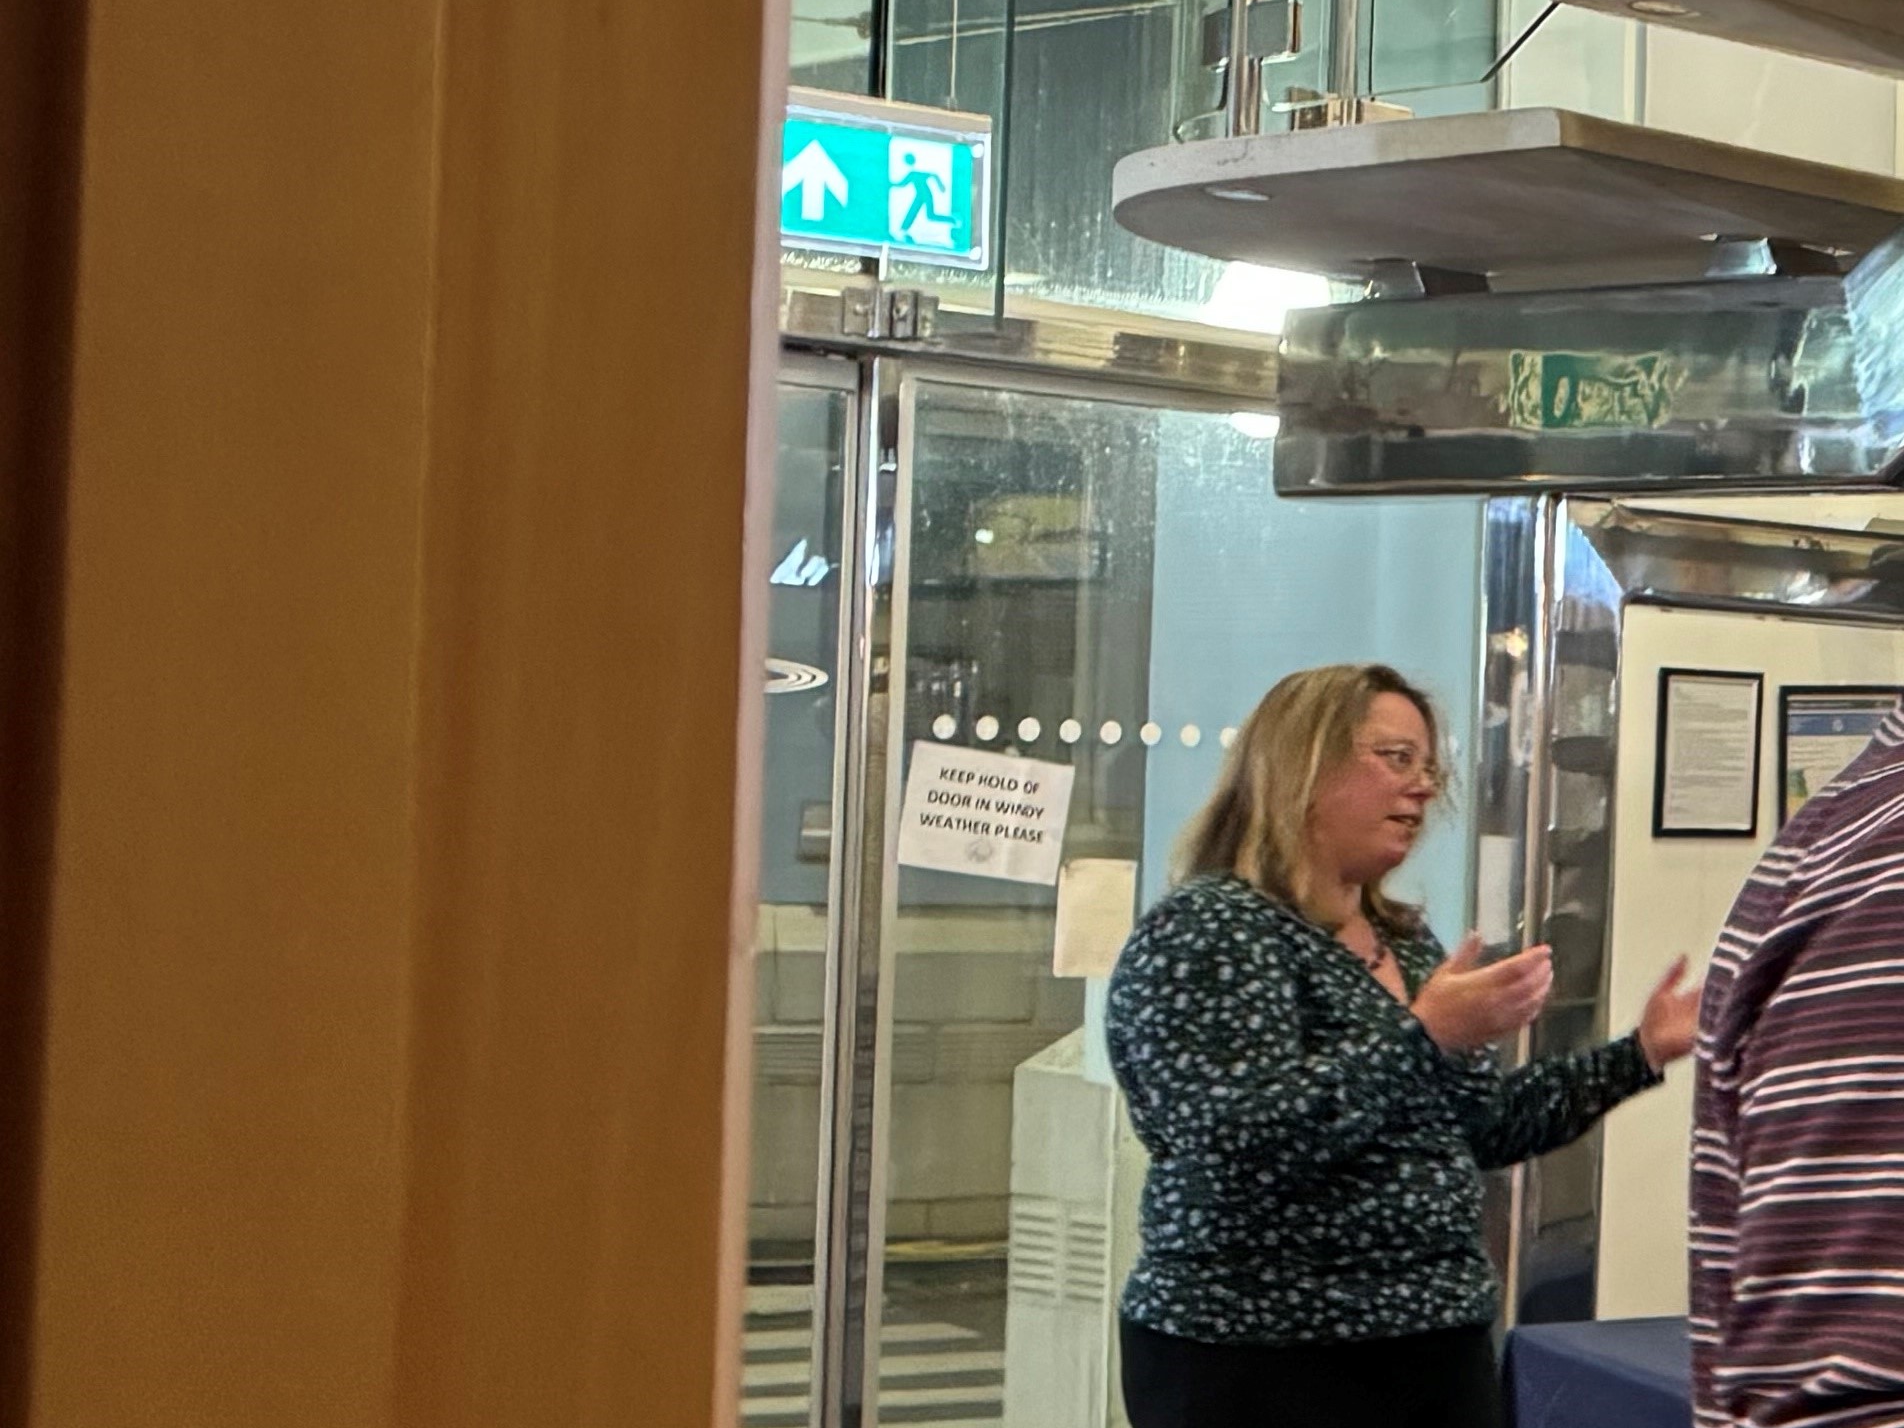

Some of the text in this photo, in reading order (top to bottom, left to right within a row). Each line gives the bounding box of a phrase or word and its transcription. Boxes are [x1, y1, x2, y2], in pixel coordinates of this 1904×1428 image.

[939, 766, 1041, 794] KEEP HOLD OF
[927, 789, 1045, 820] DOOR IN WINDY
[919, 812, 1044, 844] WEATHER PLEASE
